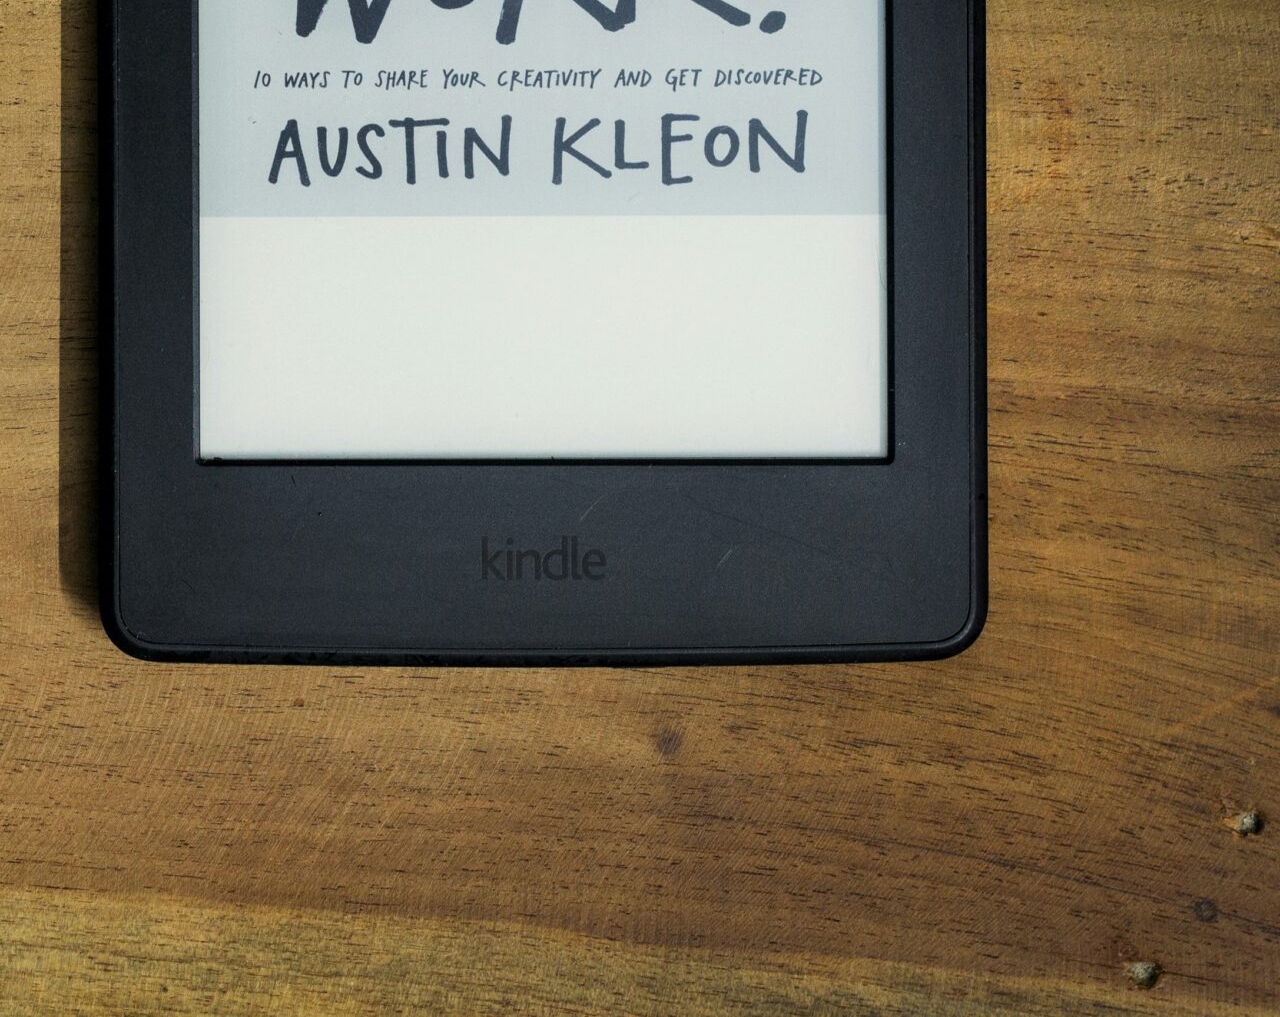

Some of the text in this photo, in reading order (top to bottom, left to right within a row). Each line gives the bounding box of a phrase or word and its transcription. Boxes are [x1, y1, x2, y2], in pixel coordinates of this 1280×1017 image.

[253, 67, 824, 93] 10 WAYS TO SHARE YOUR CREATIVITY AND GET DISCOVERED
[268, 109, 810, 188] AUSTIN KLEON
[481, 535, 608, 582] kindle
